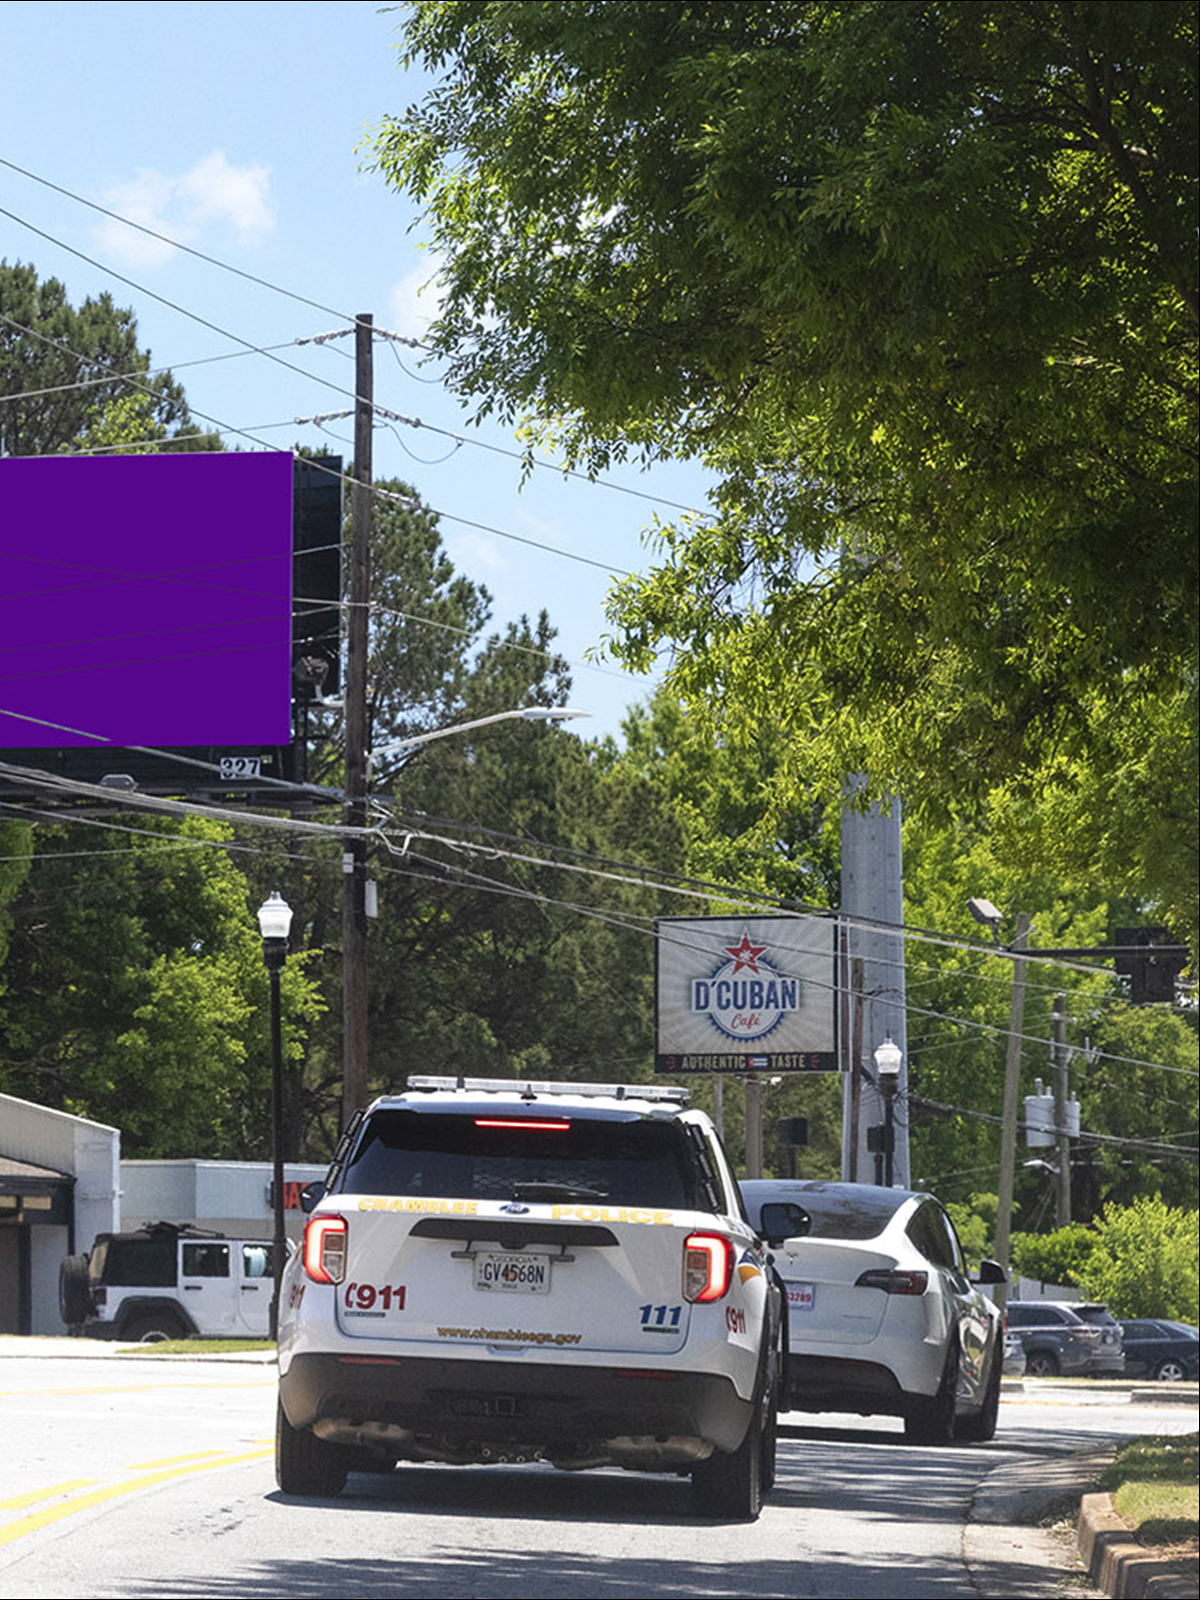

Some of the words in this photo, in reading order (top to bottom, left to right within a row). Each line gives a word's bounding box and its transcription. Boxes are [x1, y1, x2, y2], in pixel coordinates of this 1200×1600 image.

[222, 758, 260, 779] 327
[695, 980, 796, 1010] D'CUBAN
[731, 1012, 761, 1029] Café
[682, 1056, 746, 1069] AUTHENTIC
[770, 1055, 806, 1068] TASTE
[358, 1197, 478, 1215] CHAMBLEE
[552, 1204, 674, 1225] POLICE
[483, 1262, 544, 1283] GV4568N
[356, 1284, 407, 1310] 911
[639, 1304, 682, 1326] 111
